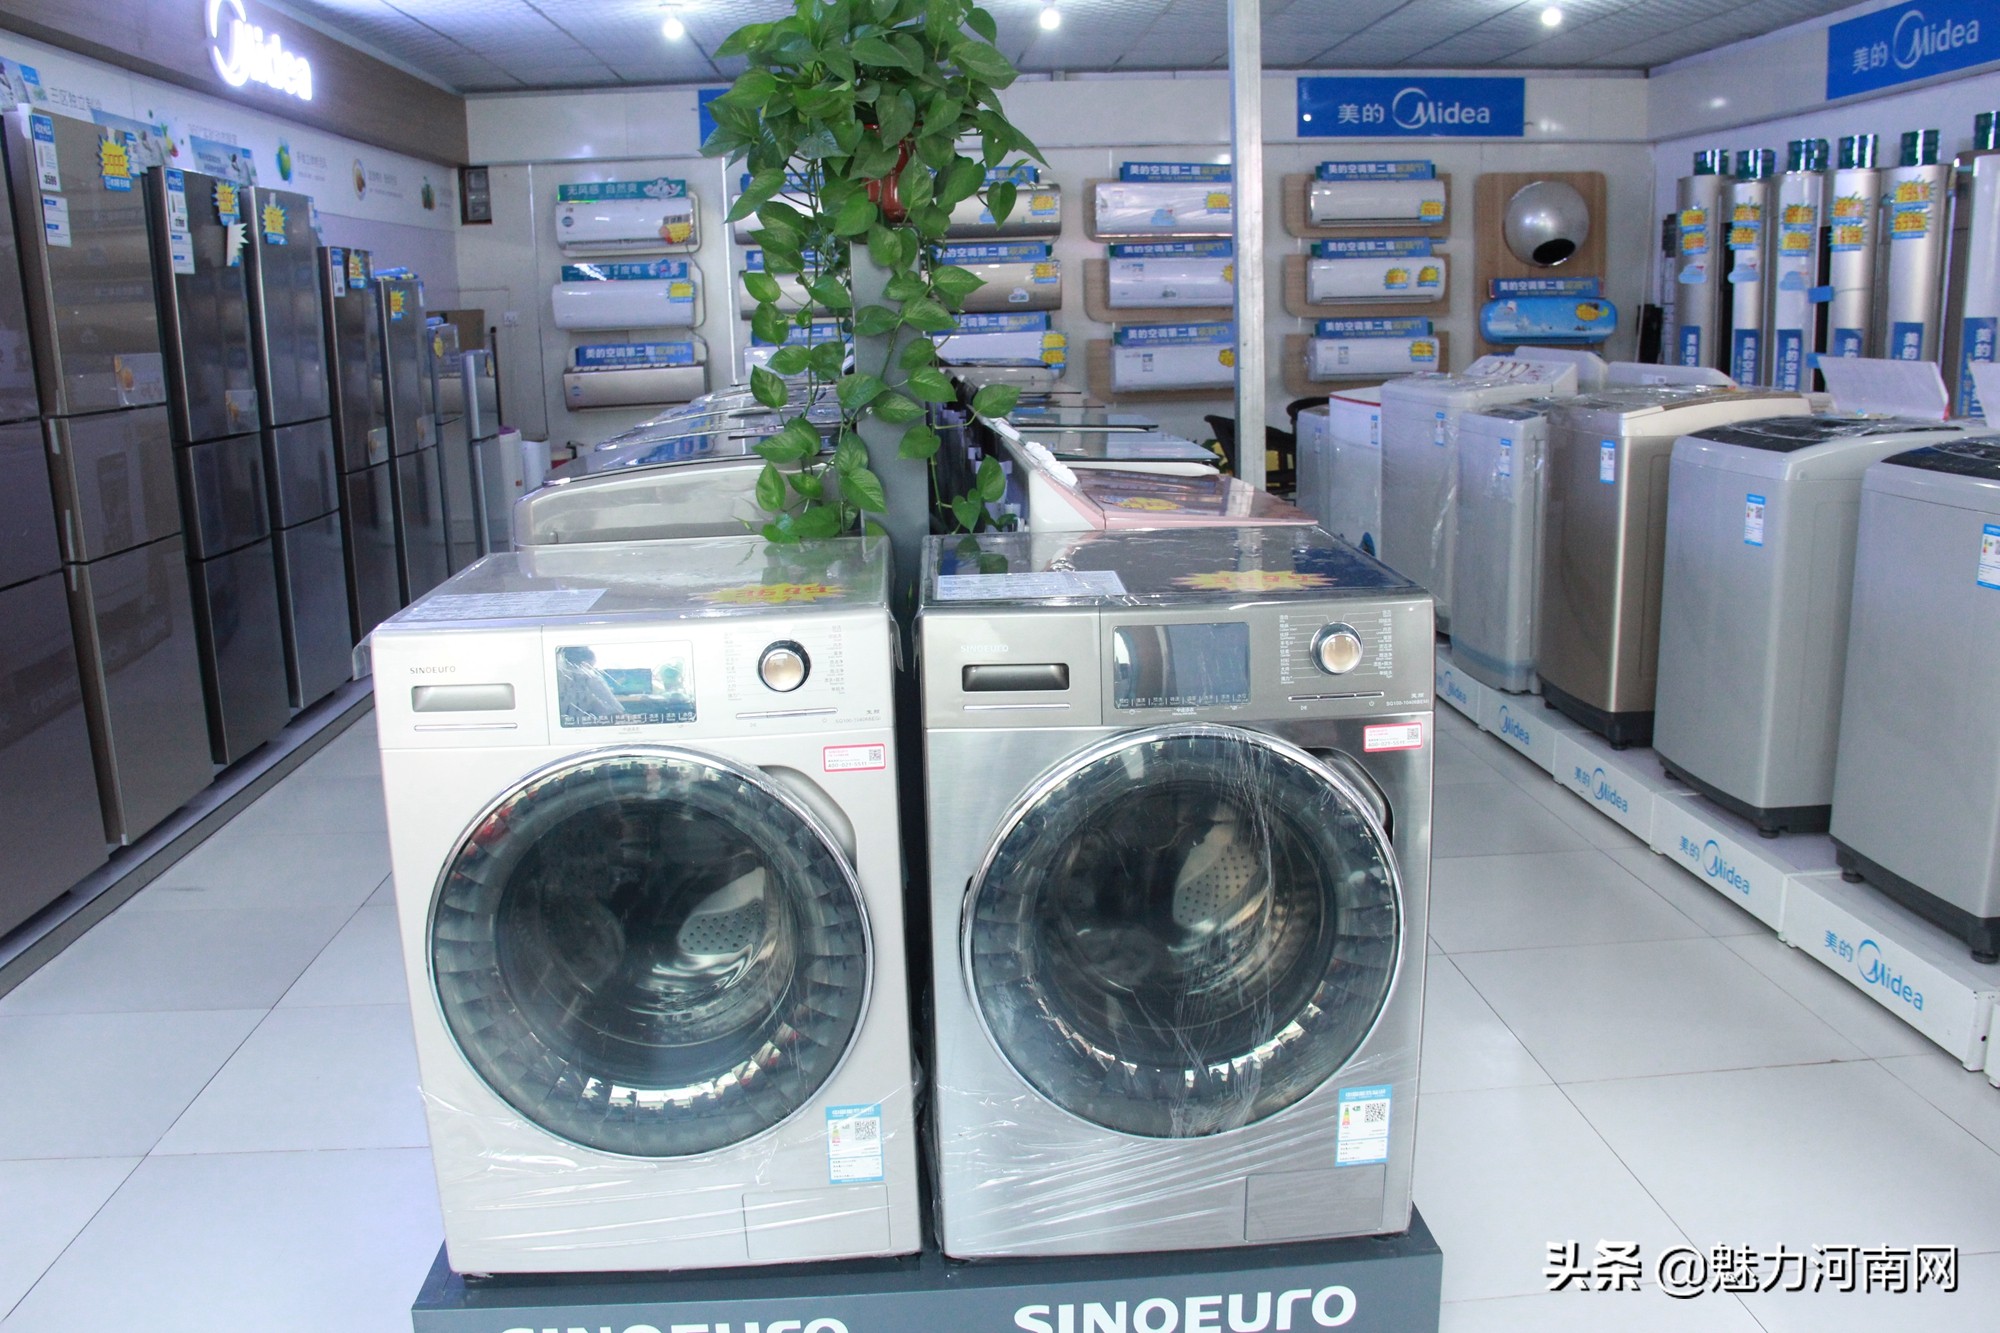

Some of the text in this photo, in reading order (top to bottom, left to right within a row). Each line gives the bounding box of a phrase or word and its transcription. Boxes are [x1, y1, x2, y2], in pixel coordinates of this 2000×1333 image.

[209, 0, 313, 101] Midea
[1853, 10, 1980, 74] 美的 Midea
[1337, 87, 1490, 129] 美的 Midea
[567, 184, 637, 195] 无风感 自然爽
[1500, 705, 1529, 746] Midea
[1575, 766, 1628, 813] 美的 Midea
[1680, 836, 1750, 895] 美的 Midea
[1825, 930, 1923, 1011] 美的 Midea
